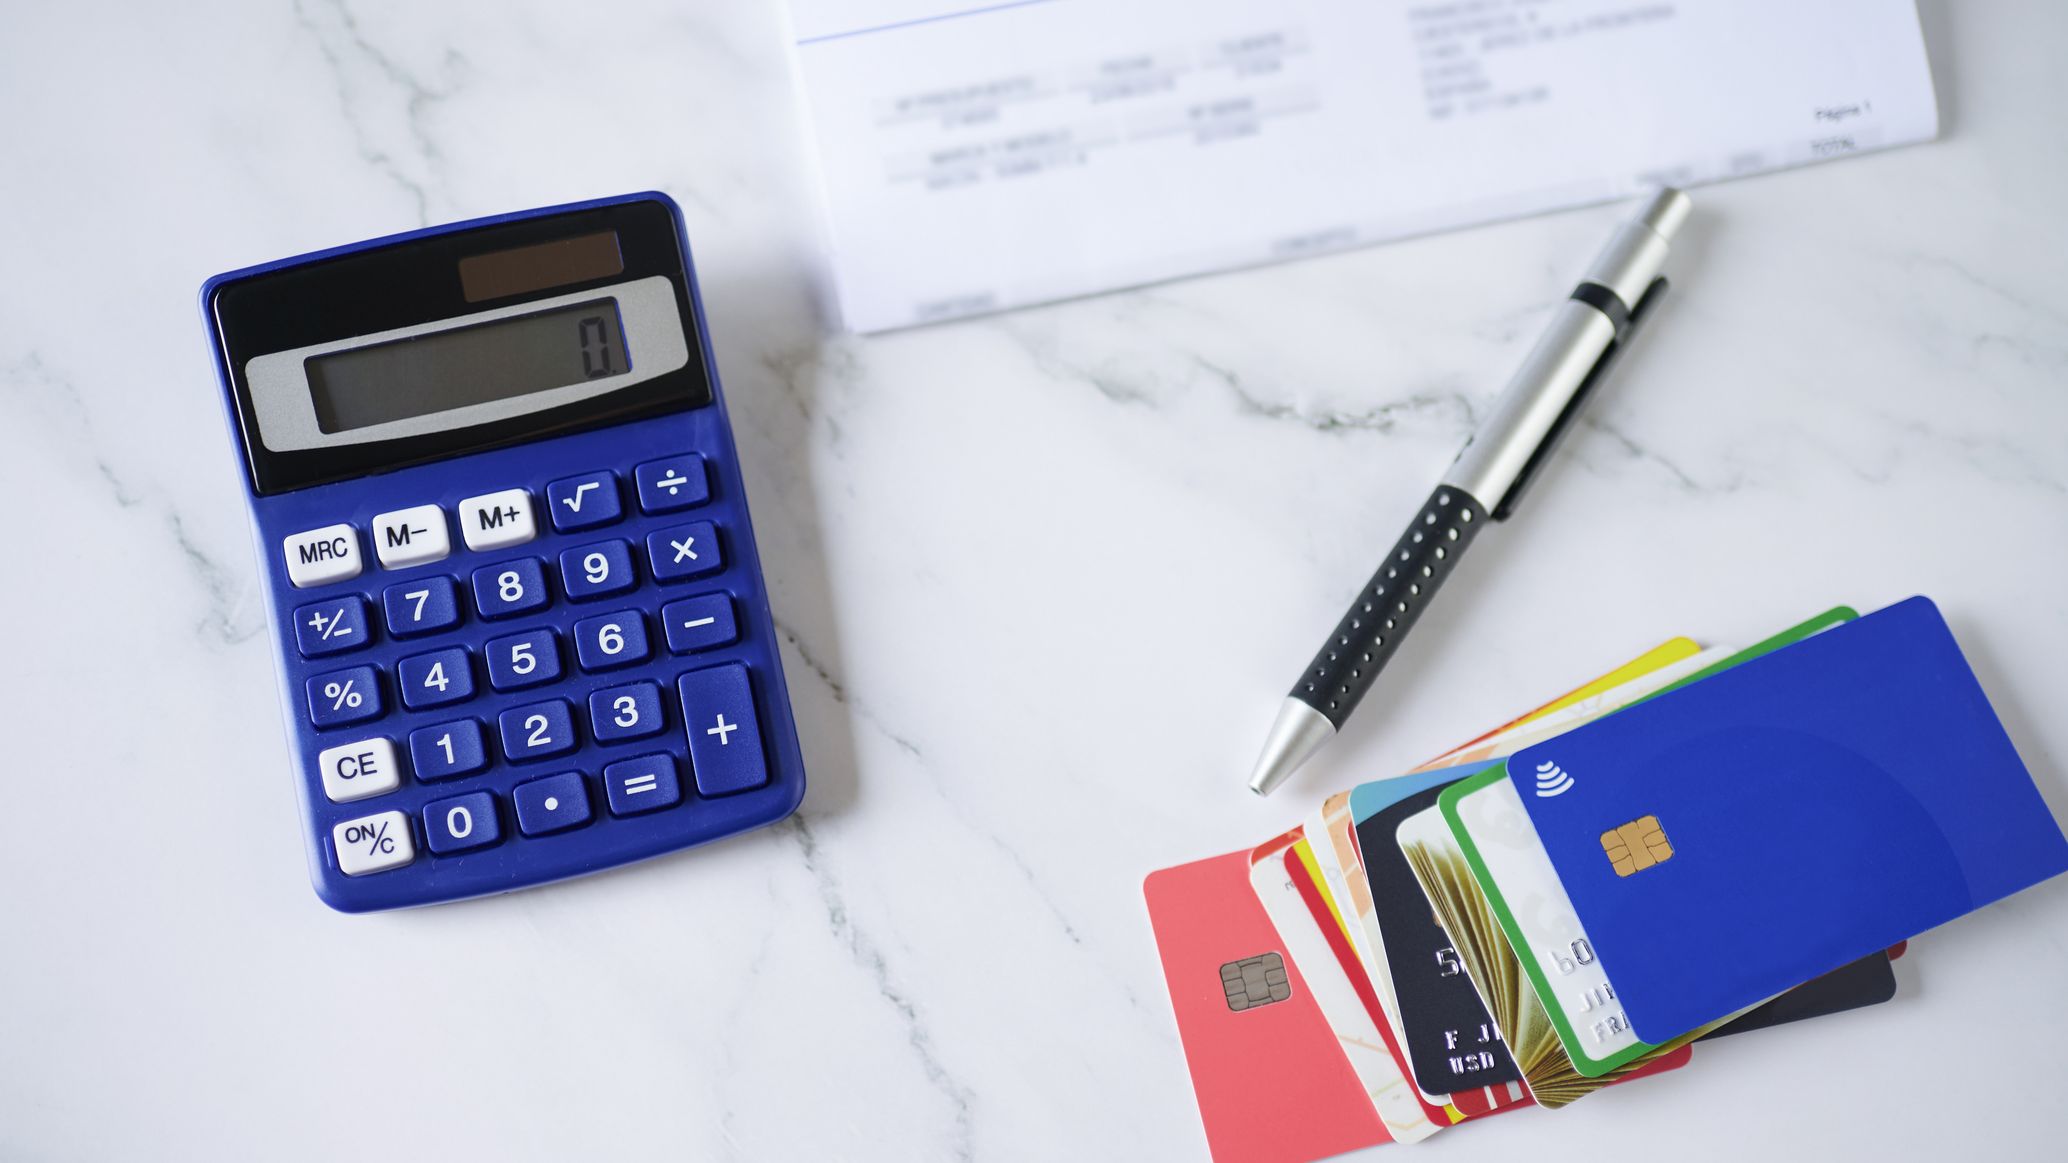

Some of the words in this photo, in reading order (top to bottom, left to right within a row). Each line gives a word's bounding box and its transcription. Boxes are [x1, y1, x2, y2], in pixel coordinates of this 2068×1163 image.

[478, 506, 521, 531] M+
[298, 536, 349, 565] MRC
[583, 552, 609, 584] 9
[497, 571, 524, 602] 8
[404, 589, 430, 622] 7
[598, 623, 625, 655] 6
[511, 642, 537, 675] 5
[424, 661, 450, 692] 4
[324, 679, 363, 711] %
[613, 695, 639, 728] 3
[524, 714, 552, 747] 2
[707, 713, 738, 745] +
[436, 733, 455, 765] 1
[335, 756, 378, 780] CE
[624, 773, 657, 795] =
[446, 806, 473, 839] 0
[1436, 947, 1465, 977] 5
[1444, 1029, 1459, 1050] F
[1449, 1051, 1495, 1075] USD
